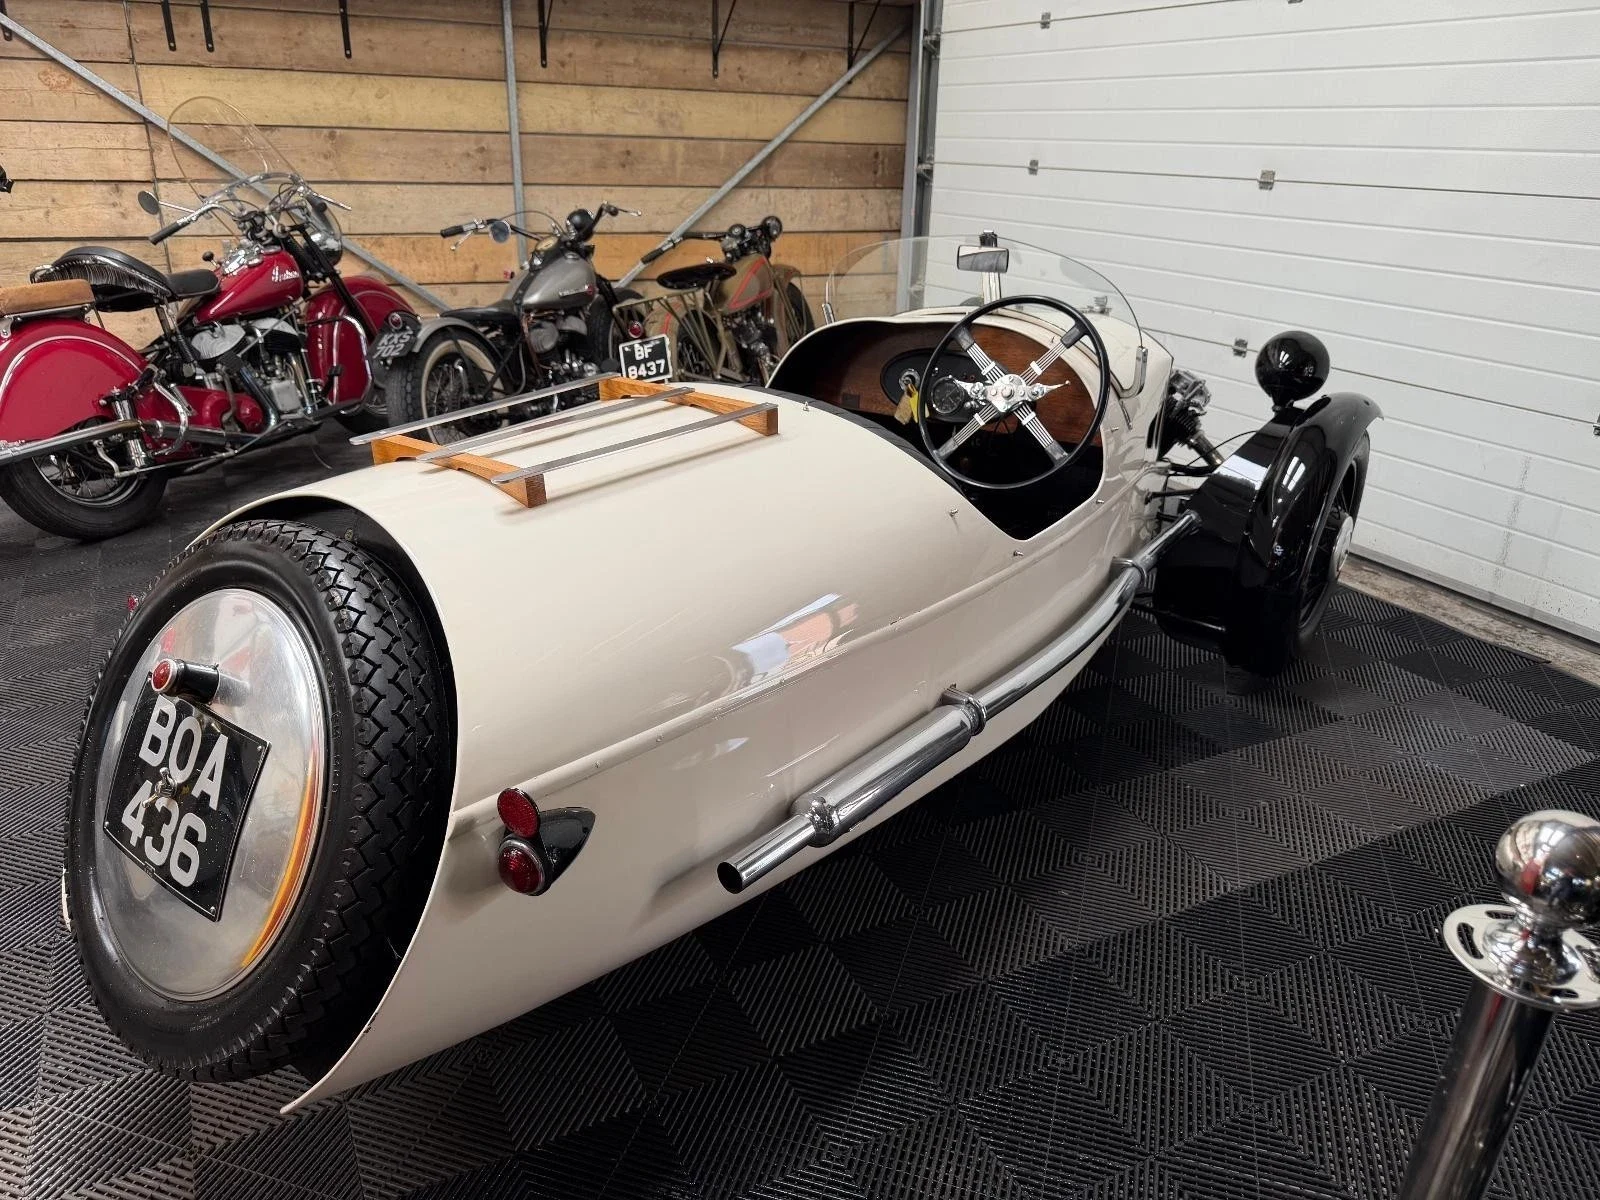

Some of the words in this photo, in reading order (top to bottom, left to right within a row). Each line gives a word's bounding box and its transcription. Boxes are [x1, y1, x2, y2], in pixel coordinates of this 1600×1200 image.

[378, 331, 413, 346] KXS
[372, 343, 404, 359] 702
[633, 343, 653, 361] BF
[627, 359, 666, 380] 8437
[138, 694, 229, 811] BOA
[121, 779, 207, 888] 436
